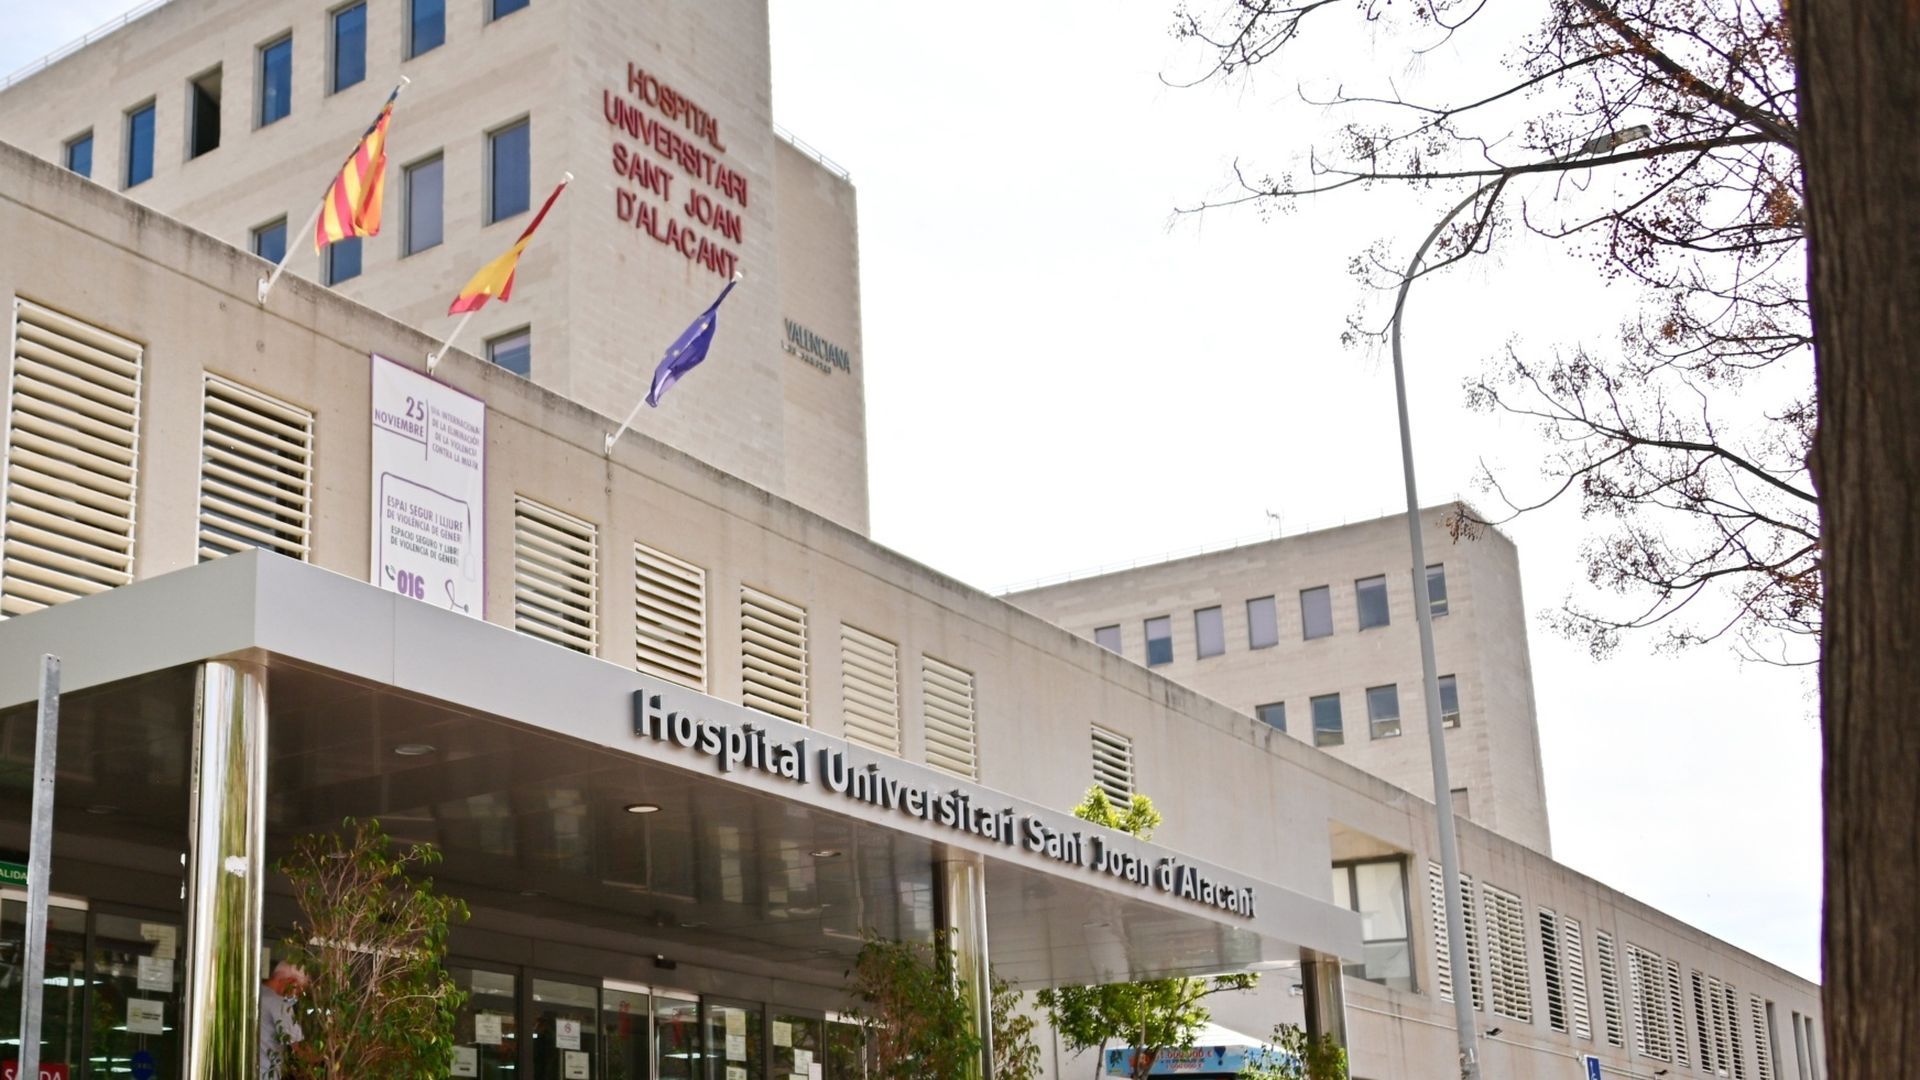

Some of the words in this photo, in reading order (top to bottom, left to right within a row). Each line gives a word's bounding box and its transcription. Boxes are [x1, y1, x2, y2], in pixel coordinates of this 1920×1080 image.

[627, 61, 726, 153] HOSPITAL
[603, 89, 747, 208] UNIVERSITARI
[612, 142, 674, 202] SANT
[684, 188, 743, 245] JOAN
[616, 187, 739, 280] D'ALACANT
[784, 317, 851, 375] VALENCIANA
[374, 408, 424, 438] NOVIEMBRE
[405, 396, 425, 421] 25
[386, 508, 395, 520] DE
[431, 524, 439, 536] DE
[387, 495, 408, 513] ESPAI
[409, 503, 434, 522] SEGUR
[390, 535, 398, 546] DE
[399, 538, 429, 557] VIOLENCIA
[429, 549, 437, 560] DE
[391, 525, 414, 541] ESPACIO
[415, 534, 438, 549] SEGURO
[397, 569, 425, 600] 016
[633, 687, 811, 785] Hospital
[819, 745, 1018, 847] Universitari
[1023, 814, 1089, 868] Sant
[1090, 834, 1153, 887] Joan
[1156, 856, 1257, 919] d'Alacant
